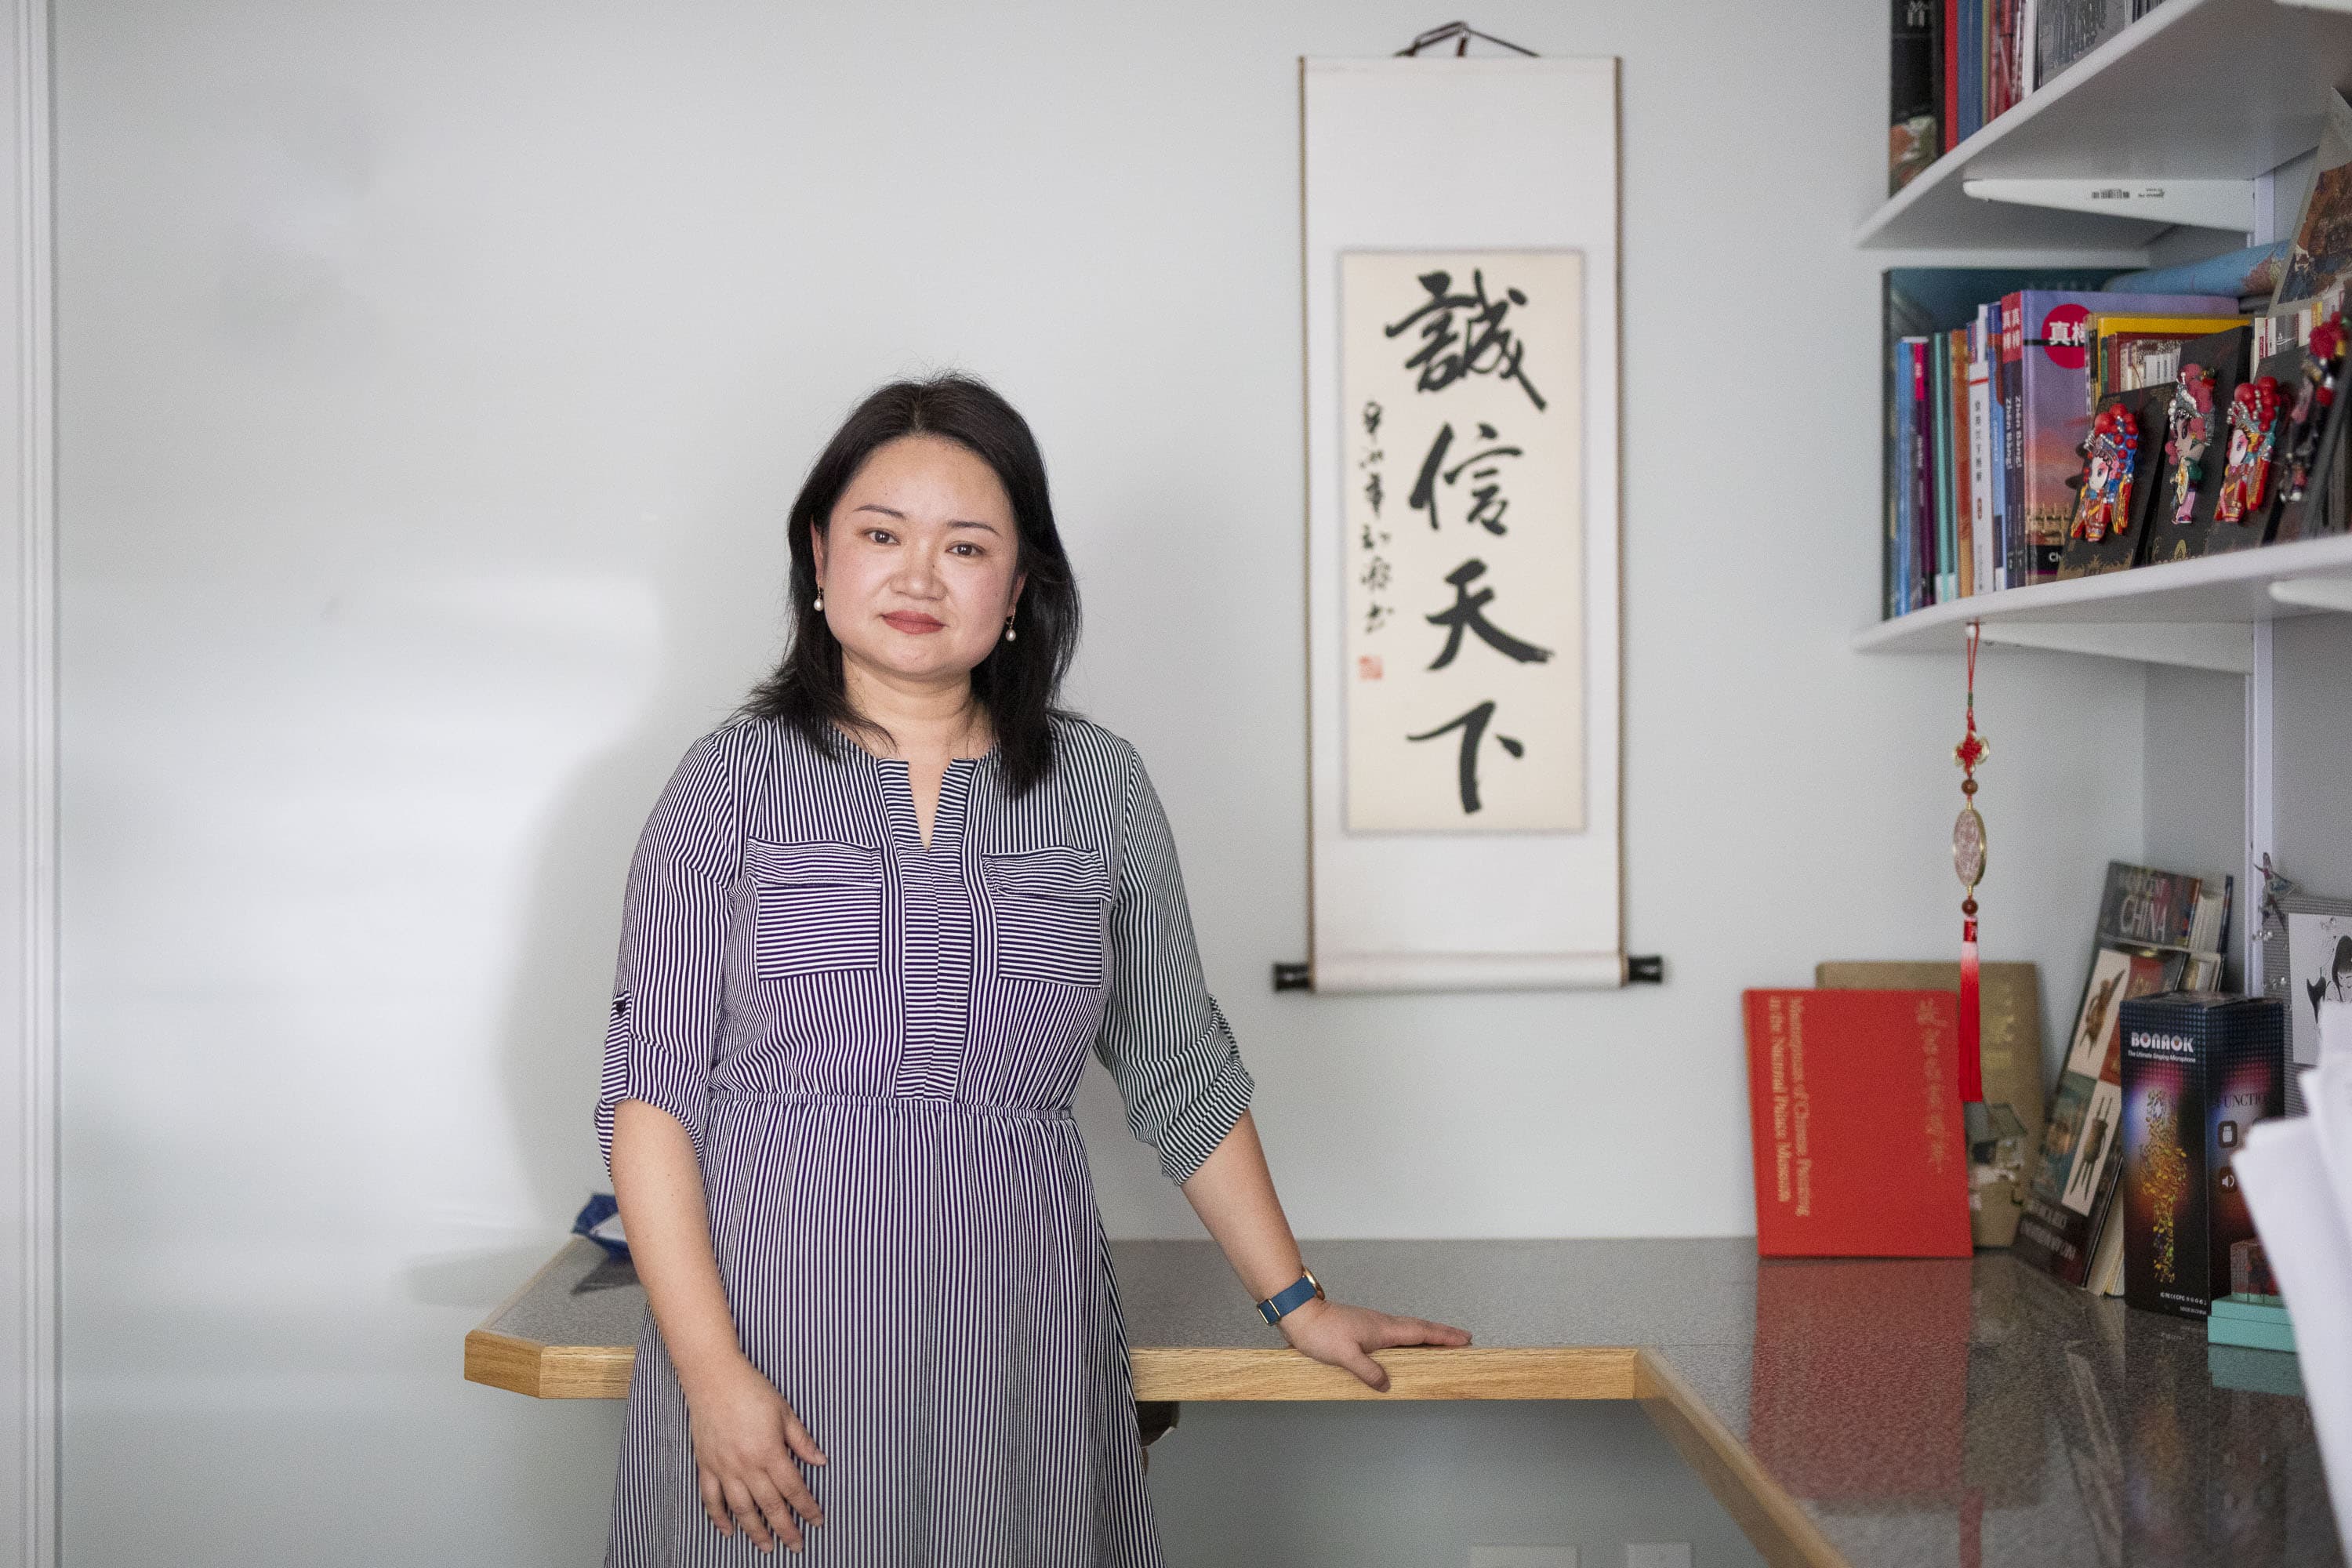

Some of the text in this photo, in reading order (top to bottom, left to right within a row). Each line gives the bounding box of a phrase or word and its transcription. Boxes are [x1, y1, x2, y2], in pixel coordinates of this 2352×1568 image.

[2120, 895, 2168, 942] CHINA
[1771, 1036, 1788, 1093] National
[2131, 1032, 2194, 1053] BONAOK
[1773, 1095, 1789, 1140] Palace
[1777, 1142, 1791, 1202] Museum
